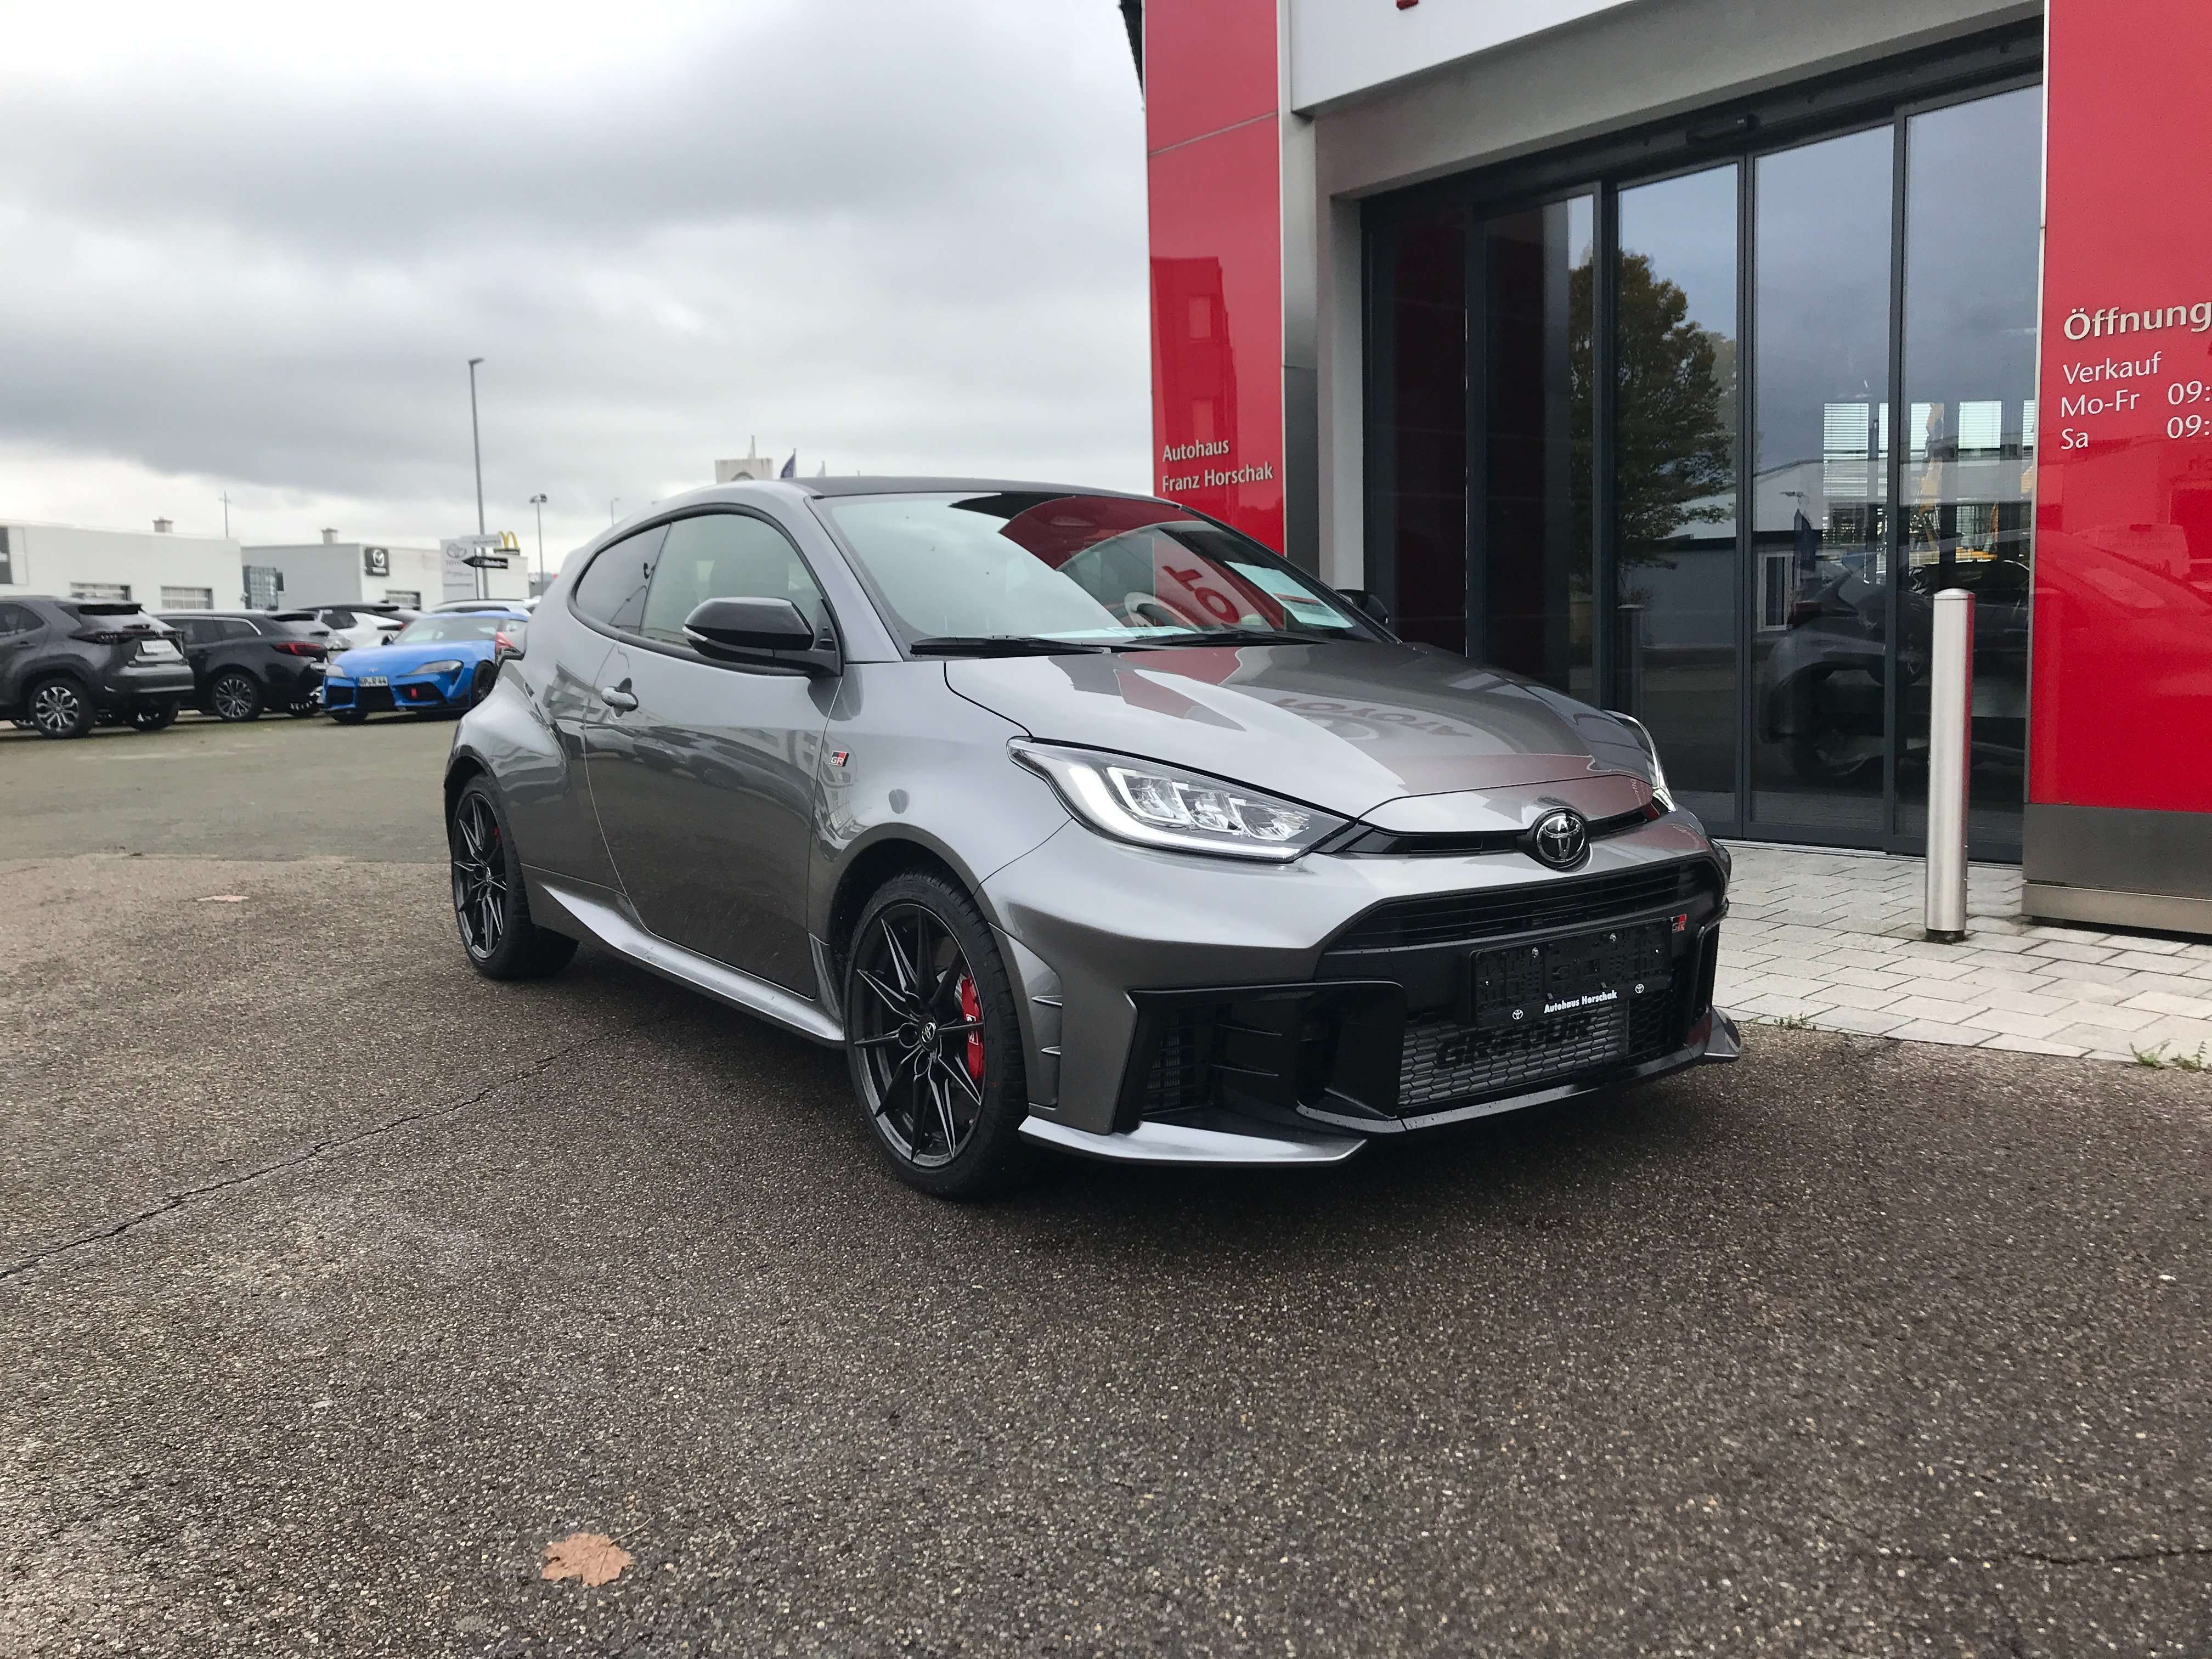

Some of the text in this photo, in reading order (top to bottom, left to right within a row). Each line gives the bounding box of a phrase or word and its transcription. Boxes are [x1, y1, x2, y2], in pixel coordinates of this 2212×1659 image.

[2063, 351, 2162, 385] Verkauf
[2061, 389, 2140, 417] Mo-Fr
[1162, 439, 1229, 462] Autohaus
[2061, 428, 2089, 450] Sa
[1163, 461, 1273, 492] Franz Horschak
[831, 756, 844, 764] GR
[1672, 921, 1685, 931] GR
[1544, 990, 1617, 1014] Autohaus Horschak
